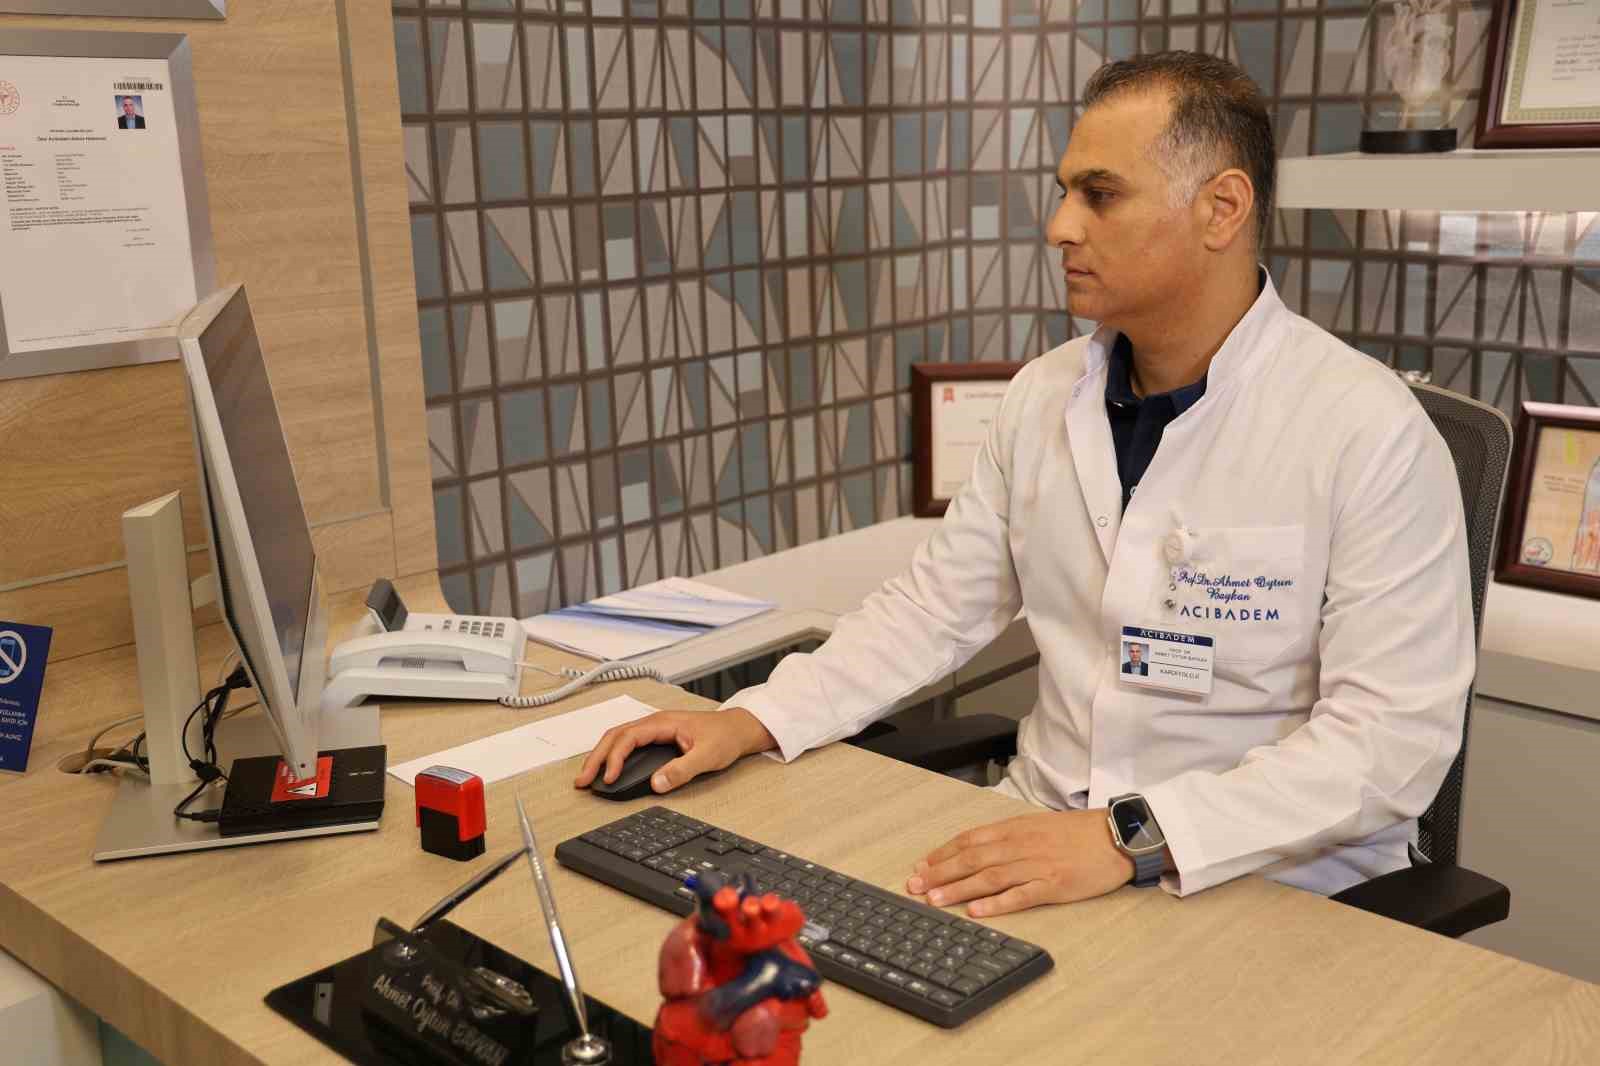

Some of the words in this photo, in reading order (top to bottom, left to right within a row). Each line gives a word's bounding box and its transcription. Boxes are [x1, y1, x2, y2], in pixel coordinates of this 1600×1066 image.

[1206, 587, 1250, 604] Baykan
[1180, 605, 1280, 621] ACIBADEM
[1140, 629, 1195, 644] ACIBADEM
[373, 973, 412, 1009] Ahmet
